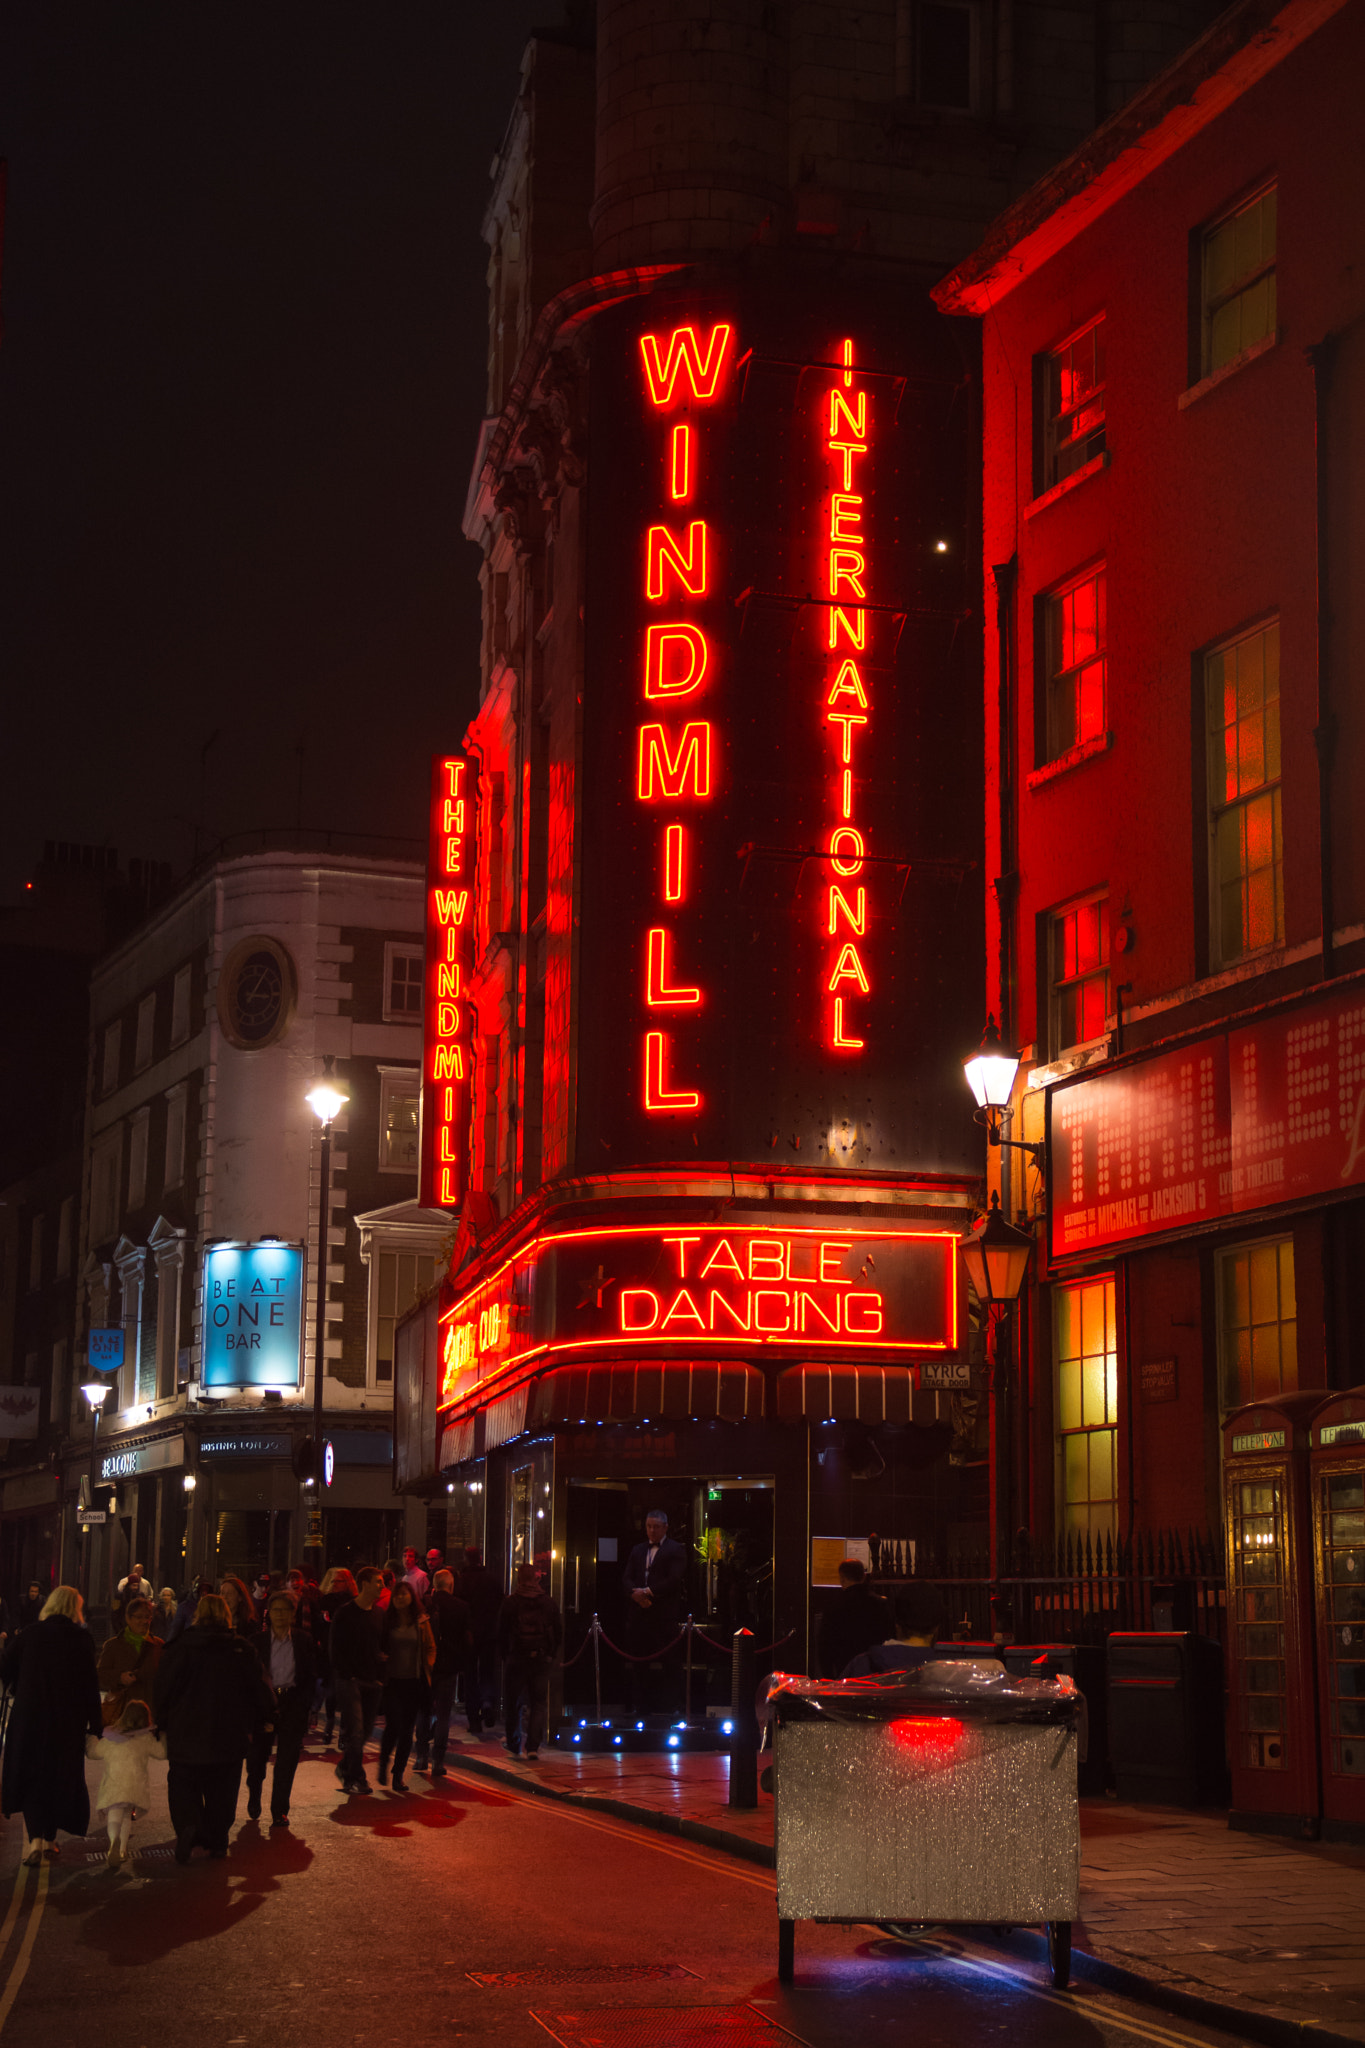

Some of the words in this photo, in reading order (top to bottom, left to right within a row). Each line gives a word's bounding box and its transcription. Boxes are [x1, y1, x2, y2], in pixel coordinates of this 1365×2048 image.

[827, 338, 870, 1049] INTERNATIONAL
[639, 323, 731, 1112] WINDMILL
[443, 760, 466, 873] THE
[432, 889, 469, 1205] WINDMILL
[1218, 1168, 1245, 1196] LYRIC
[1246, 1157, 1286, 1188] THEATRE
[1150, 1183, 1197, 1222] JACKSON
[1198, 1178, 1207, 1210] 5
[1098, 1196, 1139, 1234] MICHAEL
[1064, 1224, 1087, 1243] SONGS
[1088, 1223, 1097, 1238] OF
[662, 1235, 856, 1286] TABLE
[213, 1278, 237, 1298] BE
[250, 1278, 286, 1296] AT
[212, 1301, 285, 1328] ONE
[619, 1288, 884, 1335] DANCING
[92, 1343, 120, 1353] ONE
[225, 1332, 261, 1350] BAR
[923, 1379, 945, 1388] STAGE
[948, 1379, 969, 1388] DOOR
[924, 1365, 966, 1379] LYRIC
[200, 1441, 237, 1453] HOSTING
[239, 1440, 284, 1451] LONDO
[1234, 1431, 1284, 1451] TELEPHONE
[79, 1512, 104, 1522] School
